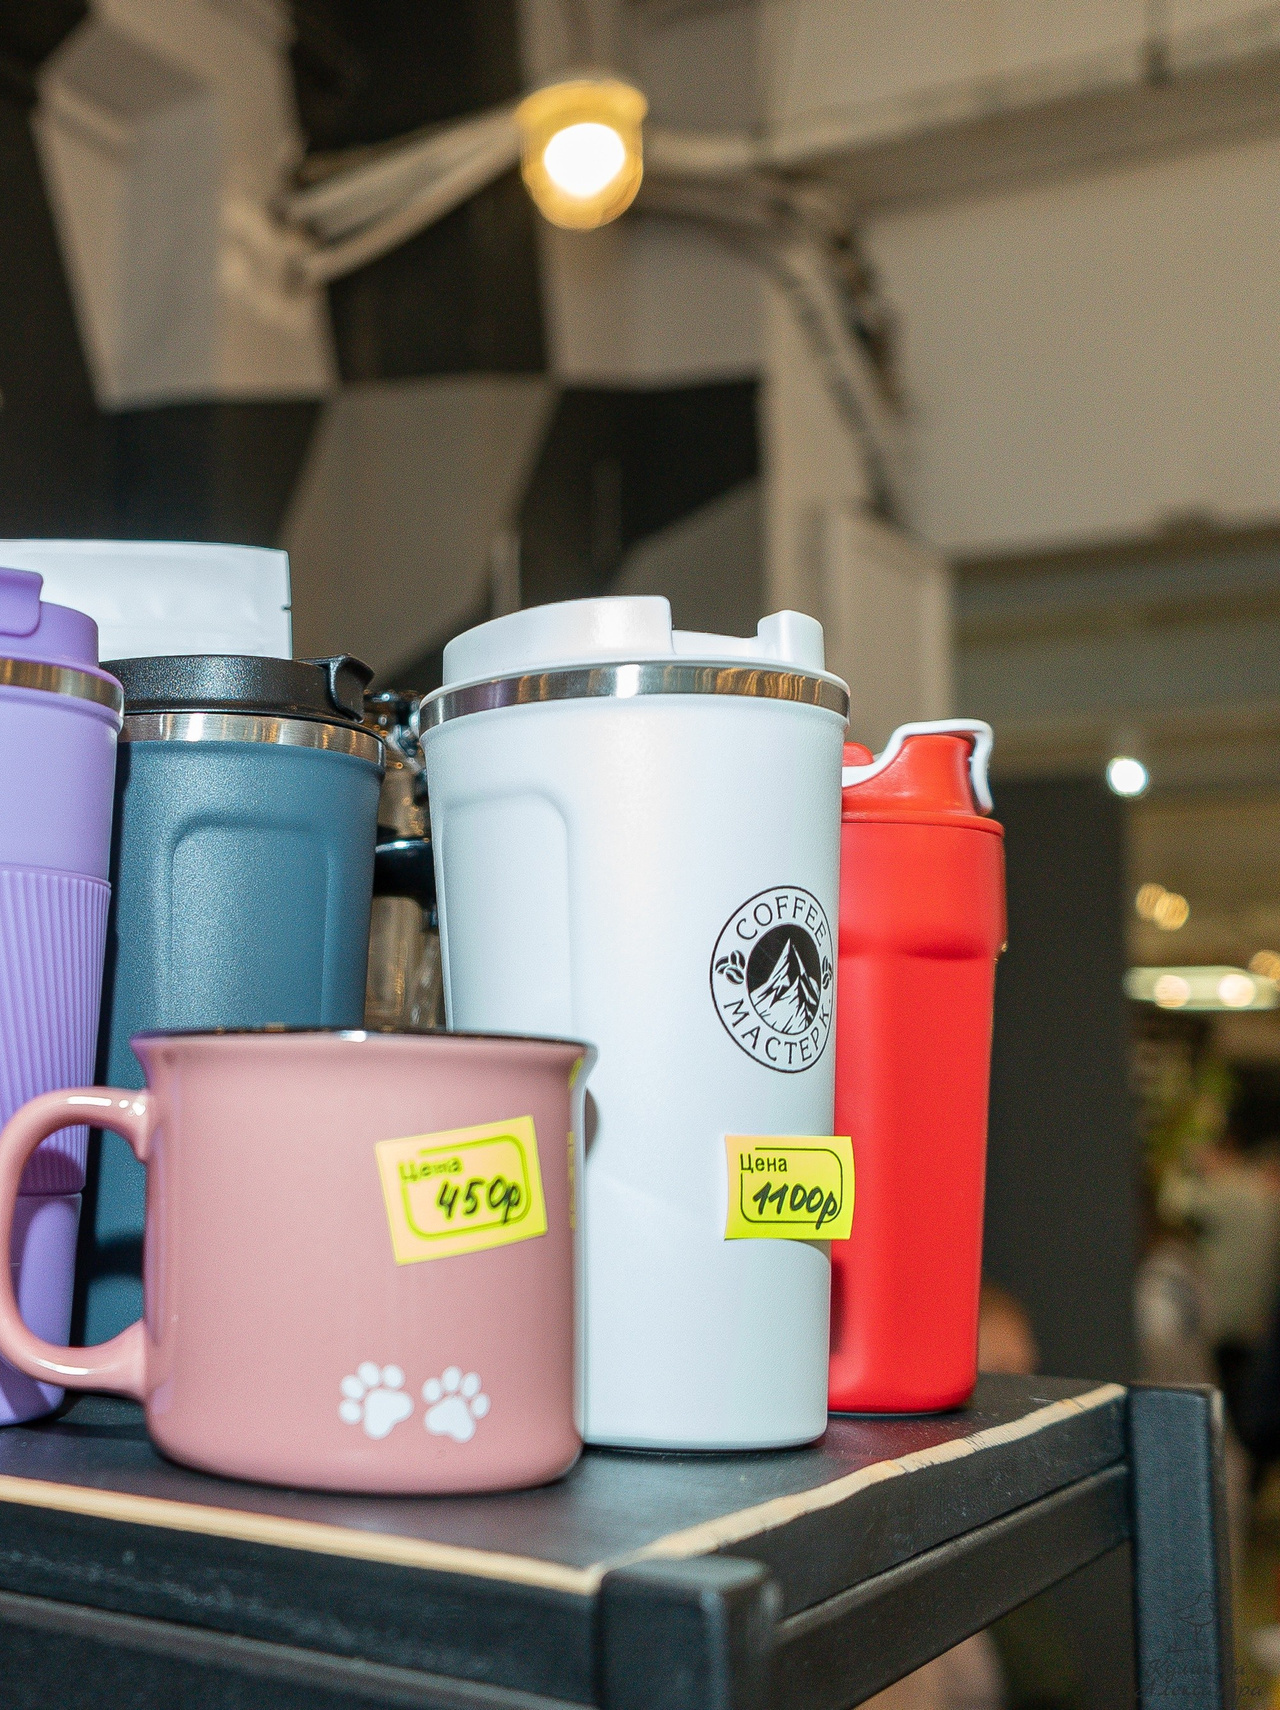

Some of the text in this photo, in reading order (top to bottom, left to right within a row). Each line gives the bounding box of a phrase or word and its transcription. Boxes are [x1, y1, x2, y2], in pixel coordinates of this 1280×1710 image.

[736, 895, 827, 947] COFFEE
[740, 1153, 788, 1173] Цена
[437, 1174, 521, 1226] 450р
[752, 1181, 839, 1231] 1100р
